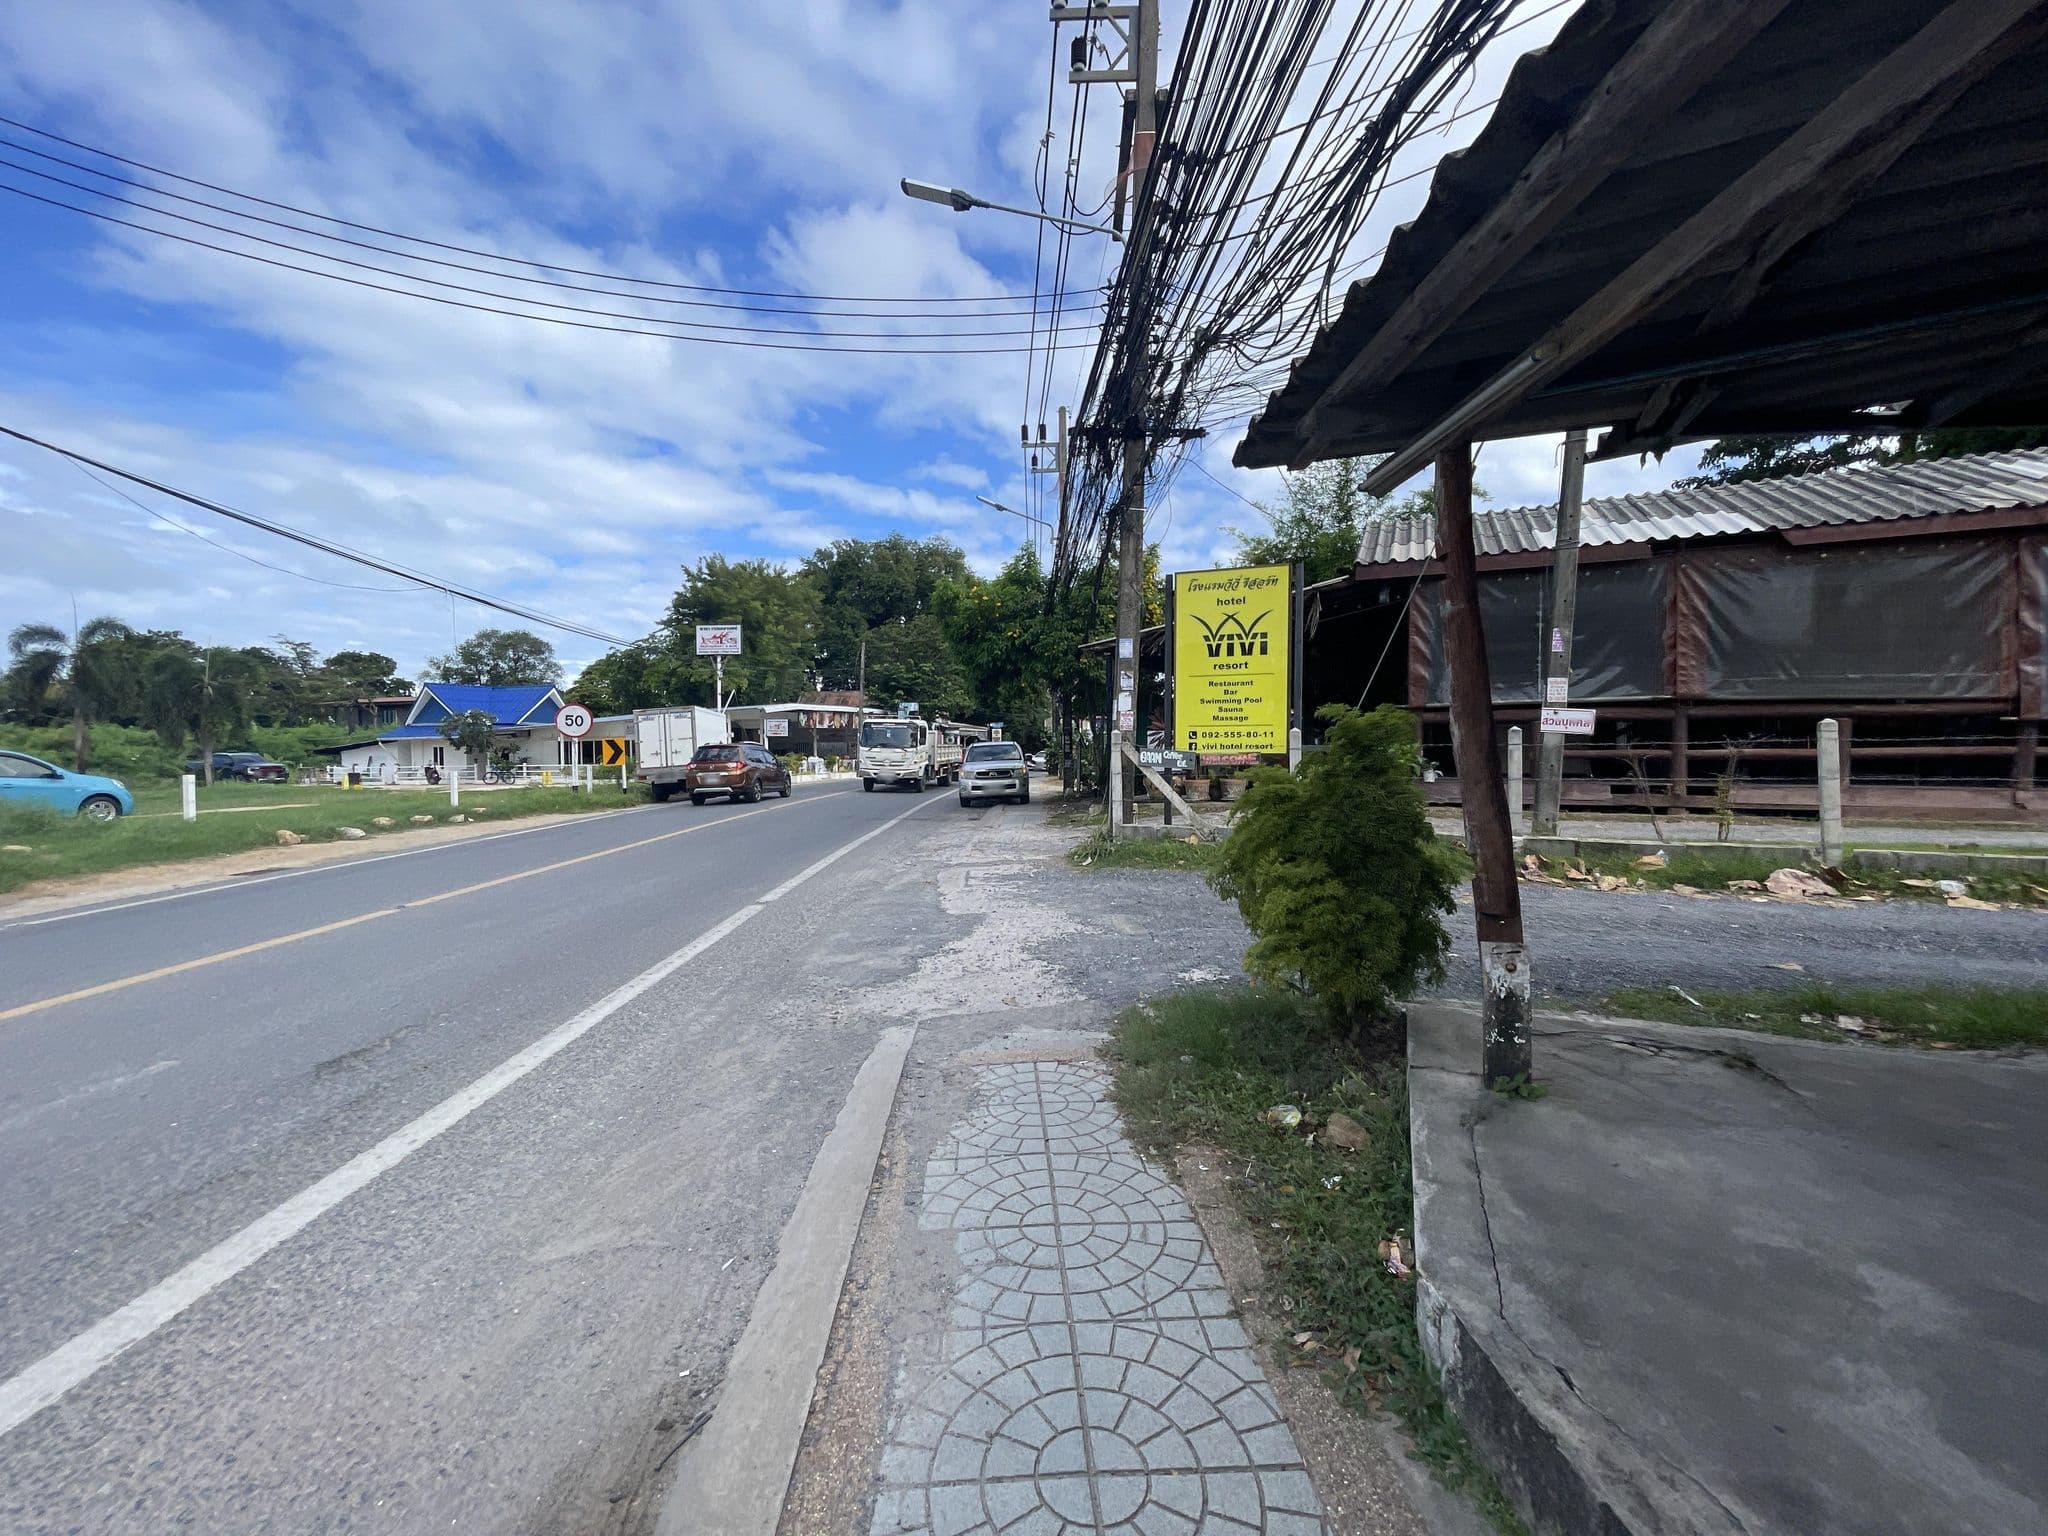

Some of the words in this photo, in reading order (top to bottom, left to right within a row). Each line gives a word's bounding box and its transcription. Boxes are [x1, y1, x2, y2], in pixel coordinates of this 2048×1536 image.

[1216, 597, 1246, 606] hotel
[1213, 661, 1249, 670] resort
[565, 715, 584, 727] 50
